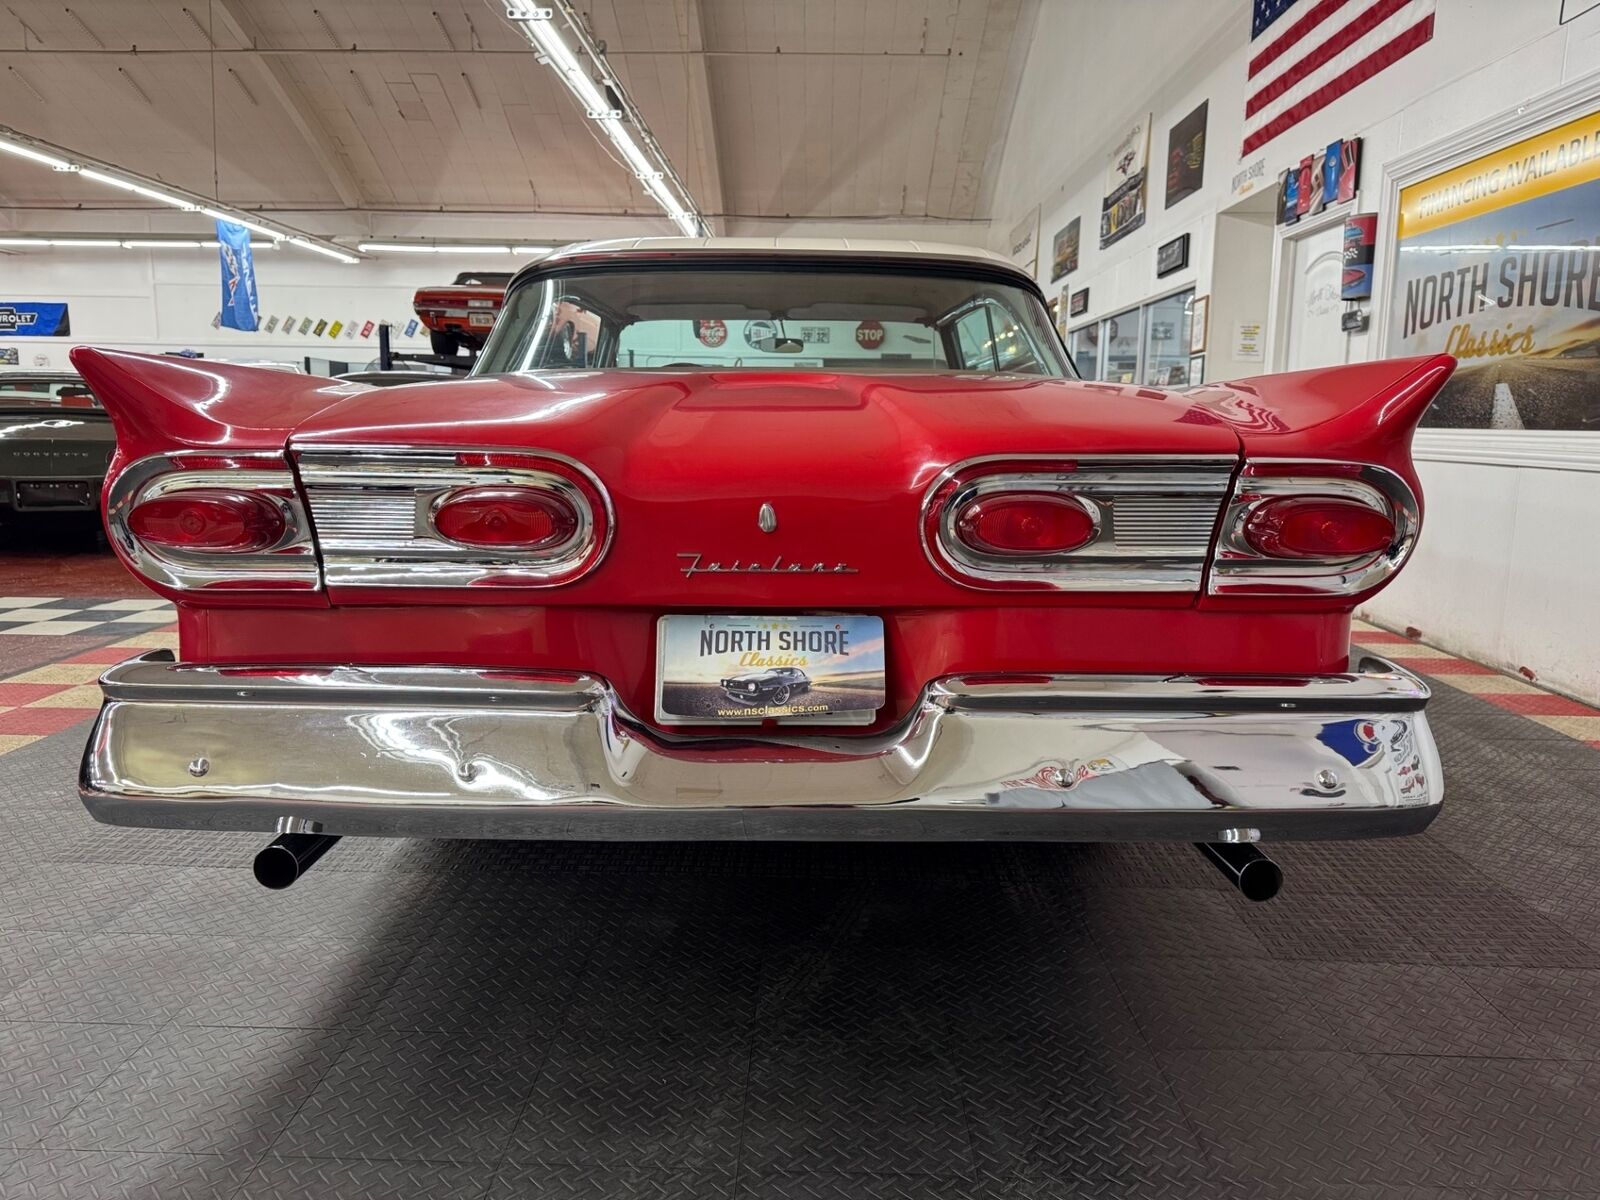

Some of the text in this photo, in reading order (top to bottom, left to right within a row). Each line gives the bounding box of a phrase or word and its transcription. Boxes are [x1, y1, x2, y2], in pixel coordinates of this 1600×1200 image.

[1419, 130, 1600, 219] FINANCING AVAILABLE
[1402, 236, 1600, 339] NORTH SHORE
[856, 329, 884, 341] STOP
[1445, 323, 1536, 358] Classics
[676, 553, 858, 578] Fairlane
[699, 629, 850, 657] NORTH SHORE
[738, 651, 809, 668] Classics
[717, 703, 829, 717] www.nsclassics.com
